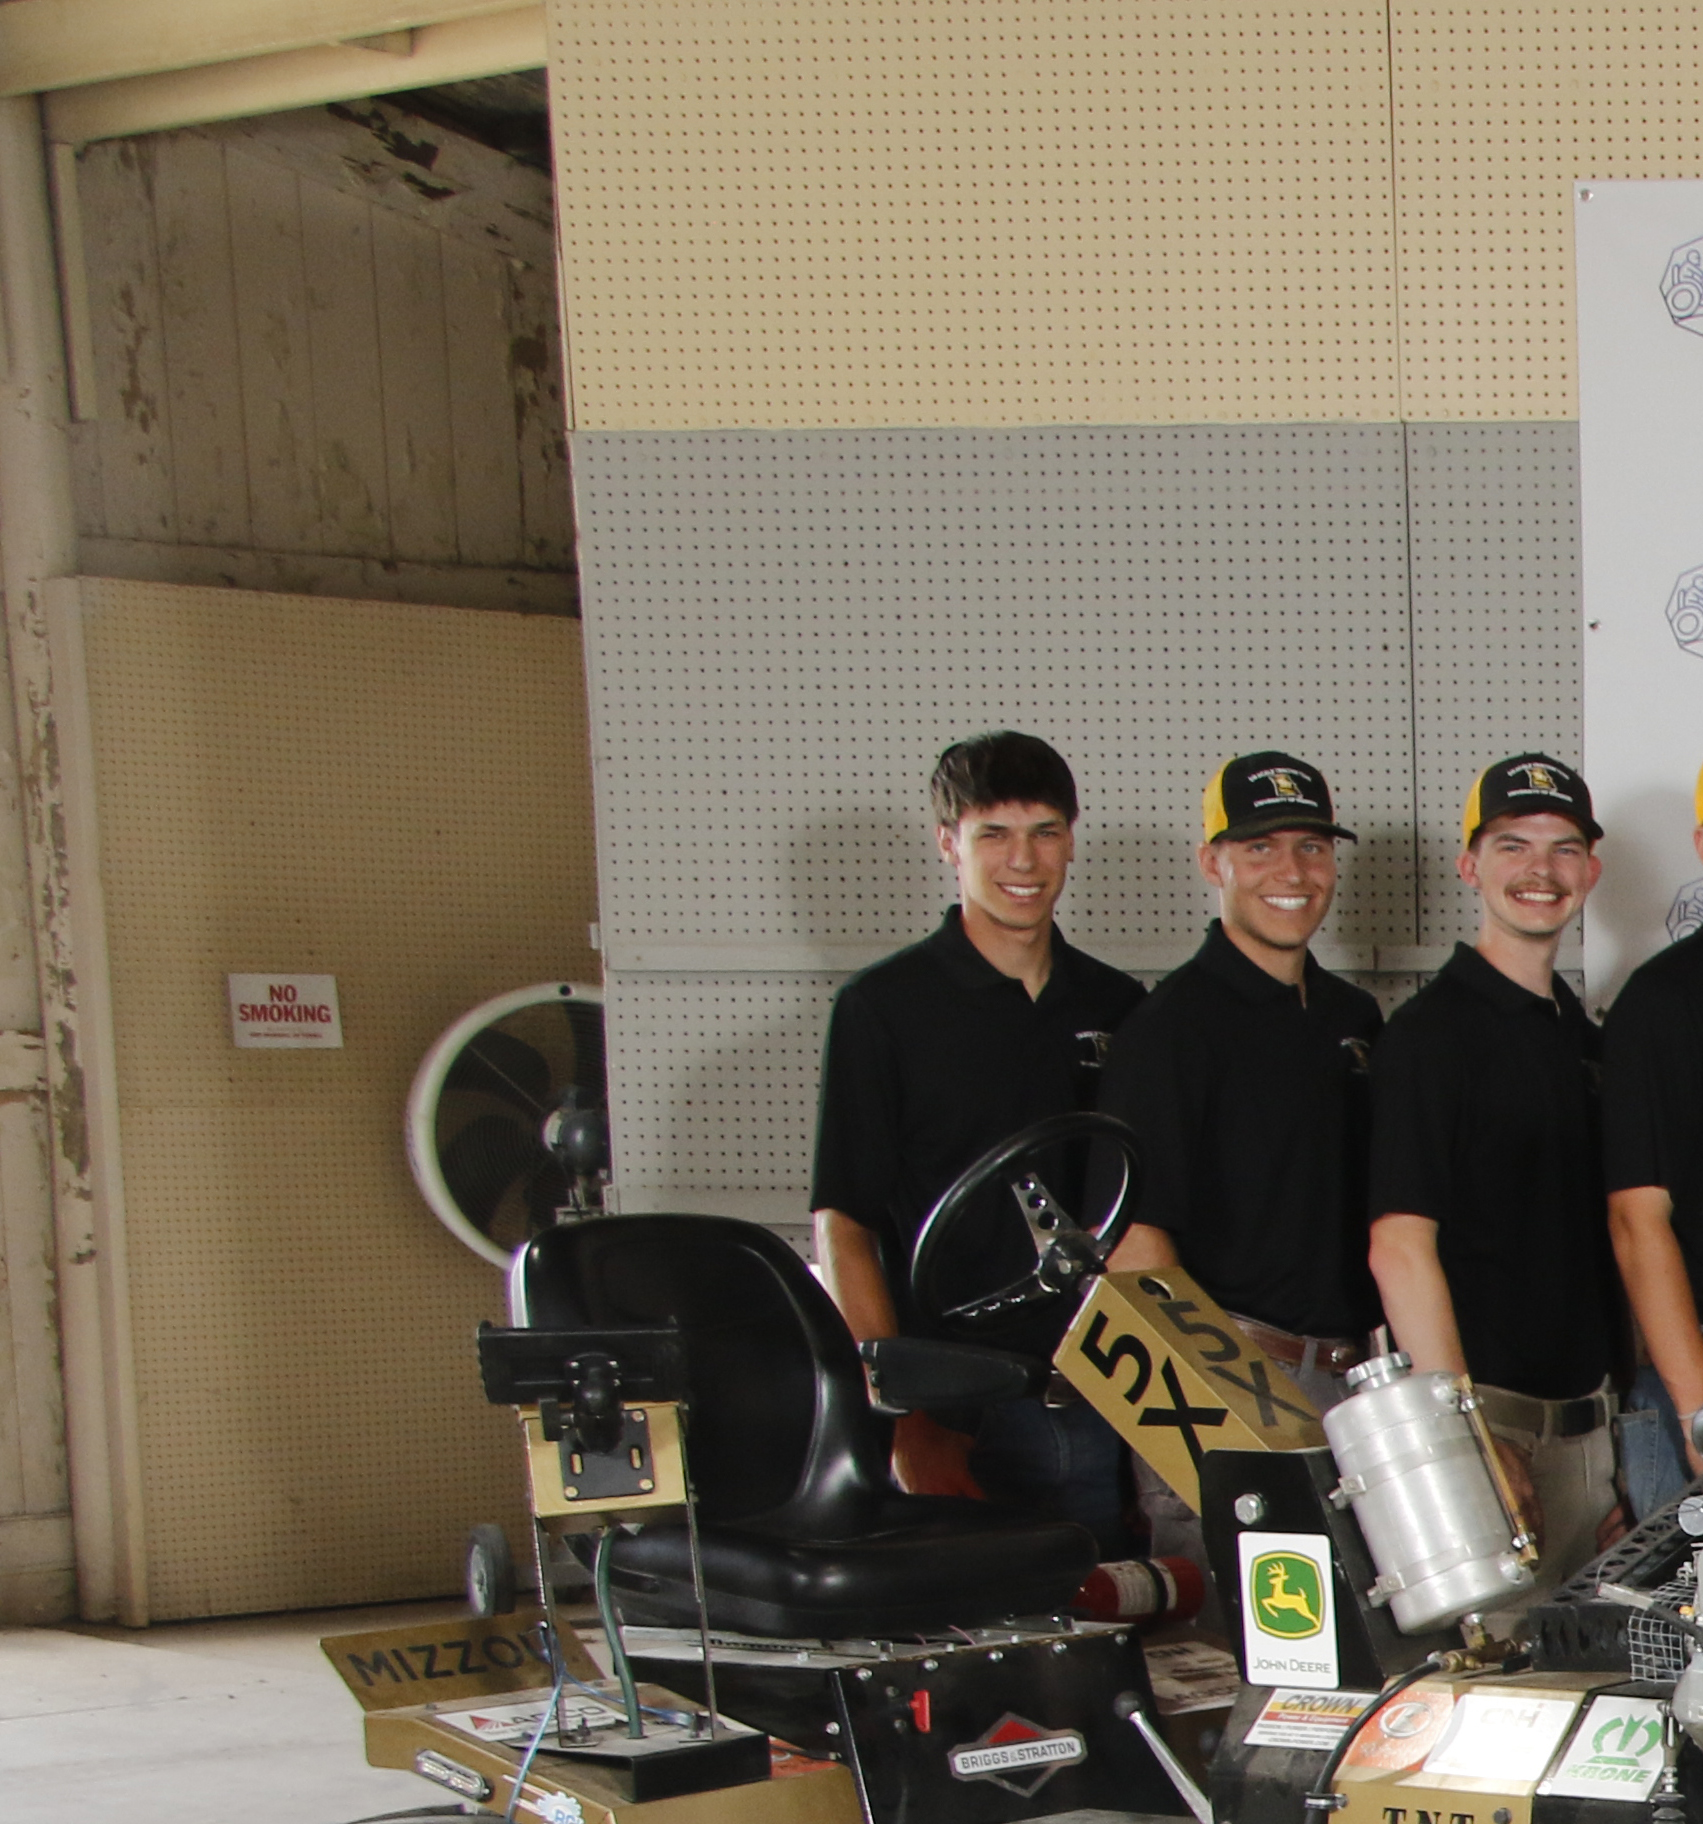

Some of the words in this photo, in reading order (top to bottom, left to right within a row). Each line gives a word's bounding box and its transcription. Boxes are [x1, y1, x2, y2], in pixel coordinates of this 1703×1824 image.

[269, 985, 298, 1003] NO
[239, 1004, 332, 1023] SMOKING
[1253, 1657, 1287, 1673] JOHN
[1289, 1659, 1332, 1675] DEERE
[1283, 1695, 1362, 1713] CROWN
[1567, 1763, 1653, 1784] KRONE
